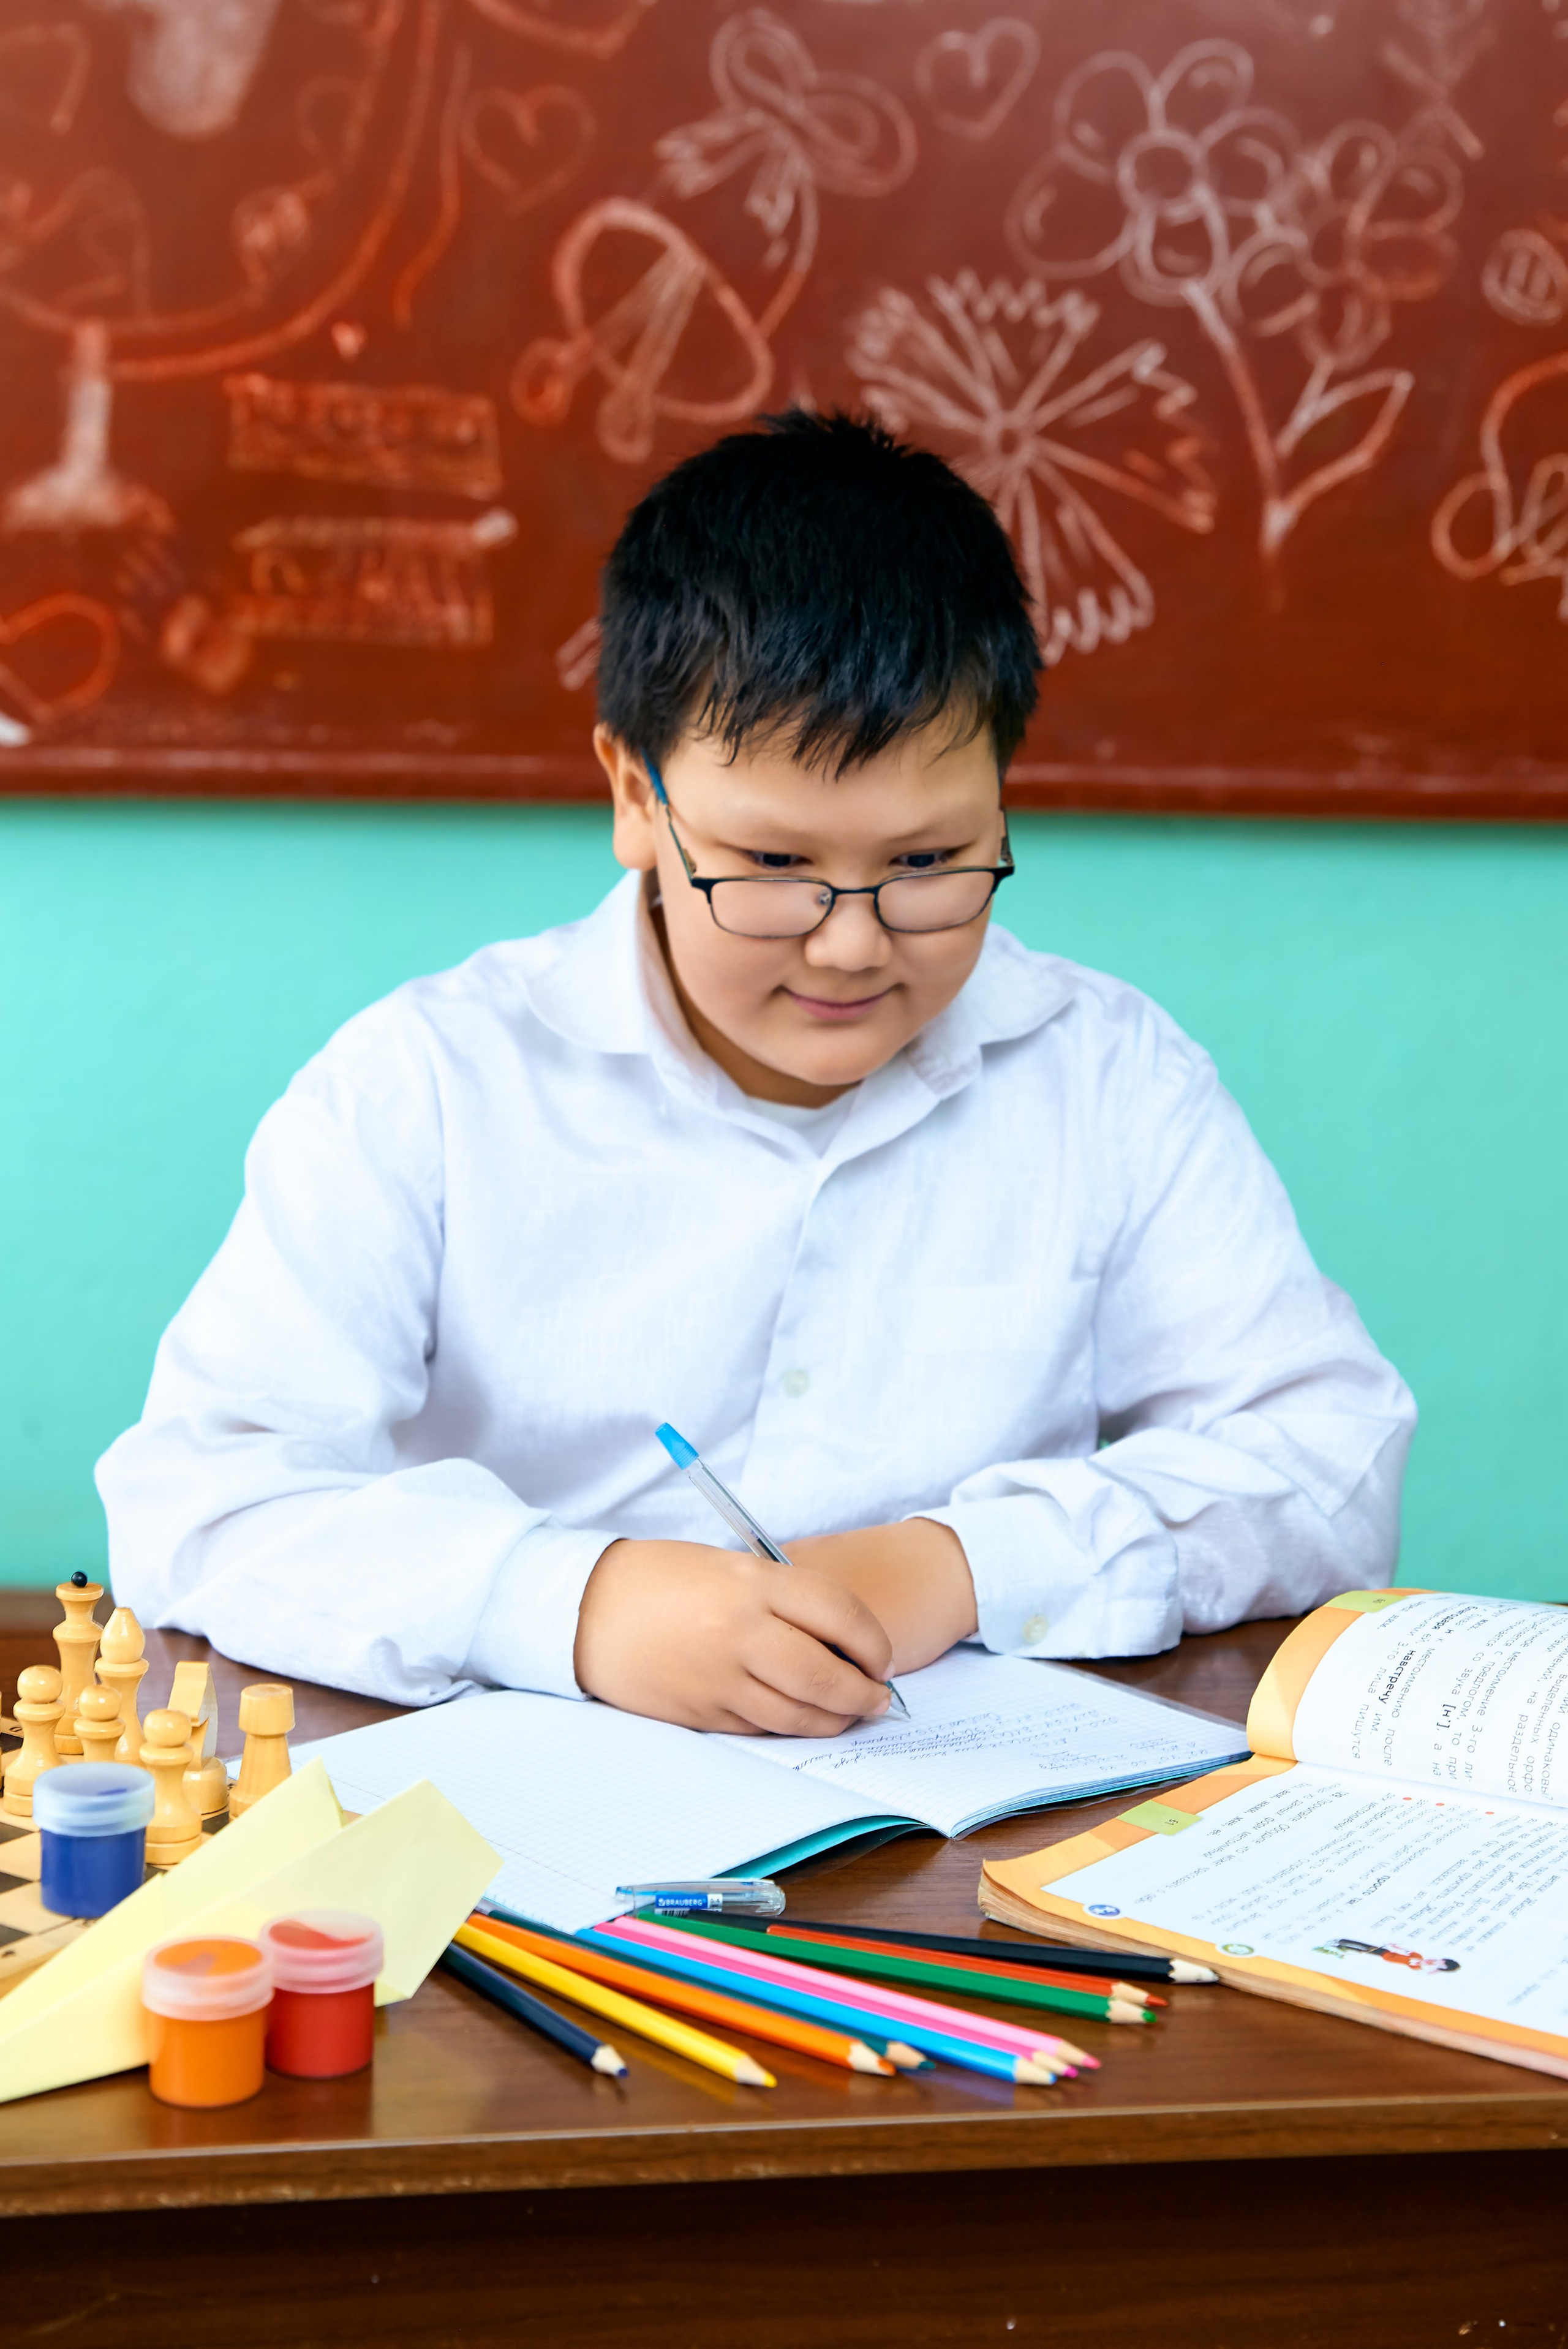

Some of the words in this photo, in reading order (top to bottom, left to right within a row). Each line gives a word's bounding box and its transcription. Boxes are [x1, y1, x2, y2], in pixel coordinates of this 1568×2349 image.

[1387, 1642, 1408, 1660] 3-го
[1473, 1653, 1484, 1661] со
[1368, 1667, 1387, 1694] лица
[1378, 1650, 1416, 1704] навстречу
[1392, 1648, 1435, 1717] местоимению
[1452, 1667, 1472, 1695] звука
[1457, 1661, 1495, 1720] предлогом,
[1477, 1651, 1521, 1716] местоимение
[1526, 1691, 1539, 1704] на
[1530, 1674, 1568, 1744] выделенных
[1351, 1704, 1369, 1759] пишутся
[1370, 1713, 1382, 1734] им.
[1384, 1729, 1395, 1766] после
[1452, 1732, 1461, 1746] то
[1467, 1724, 1483, 1753] 3-го
[1446, 1757, 1457, 1779] при
[1507, 1714, 1528, 1793] раздельное
[1540, 1722, 1561, 1801] одинаковы?
[1433, 1762, 1441, 1776] на
[1521, 1755, 1534, 1795] орфо-
[1362, 1875, 1390, 1895] просто
